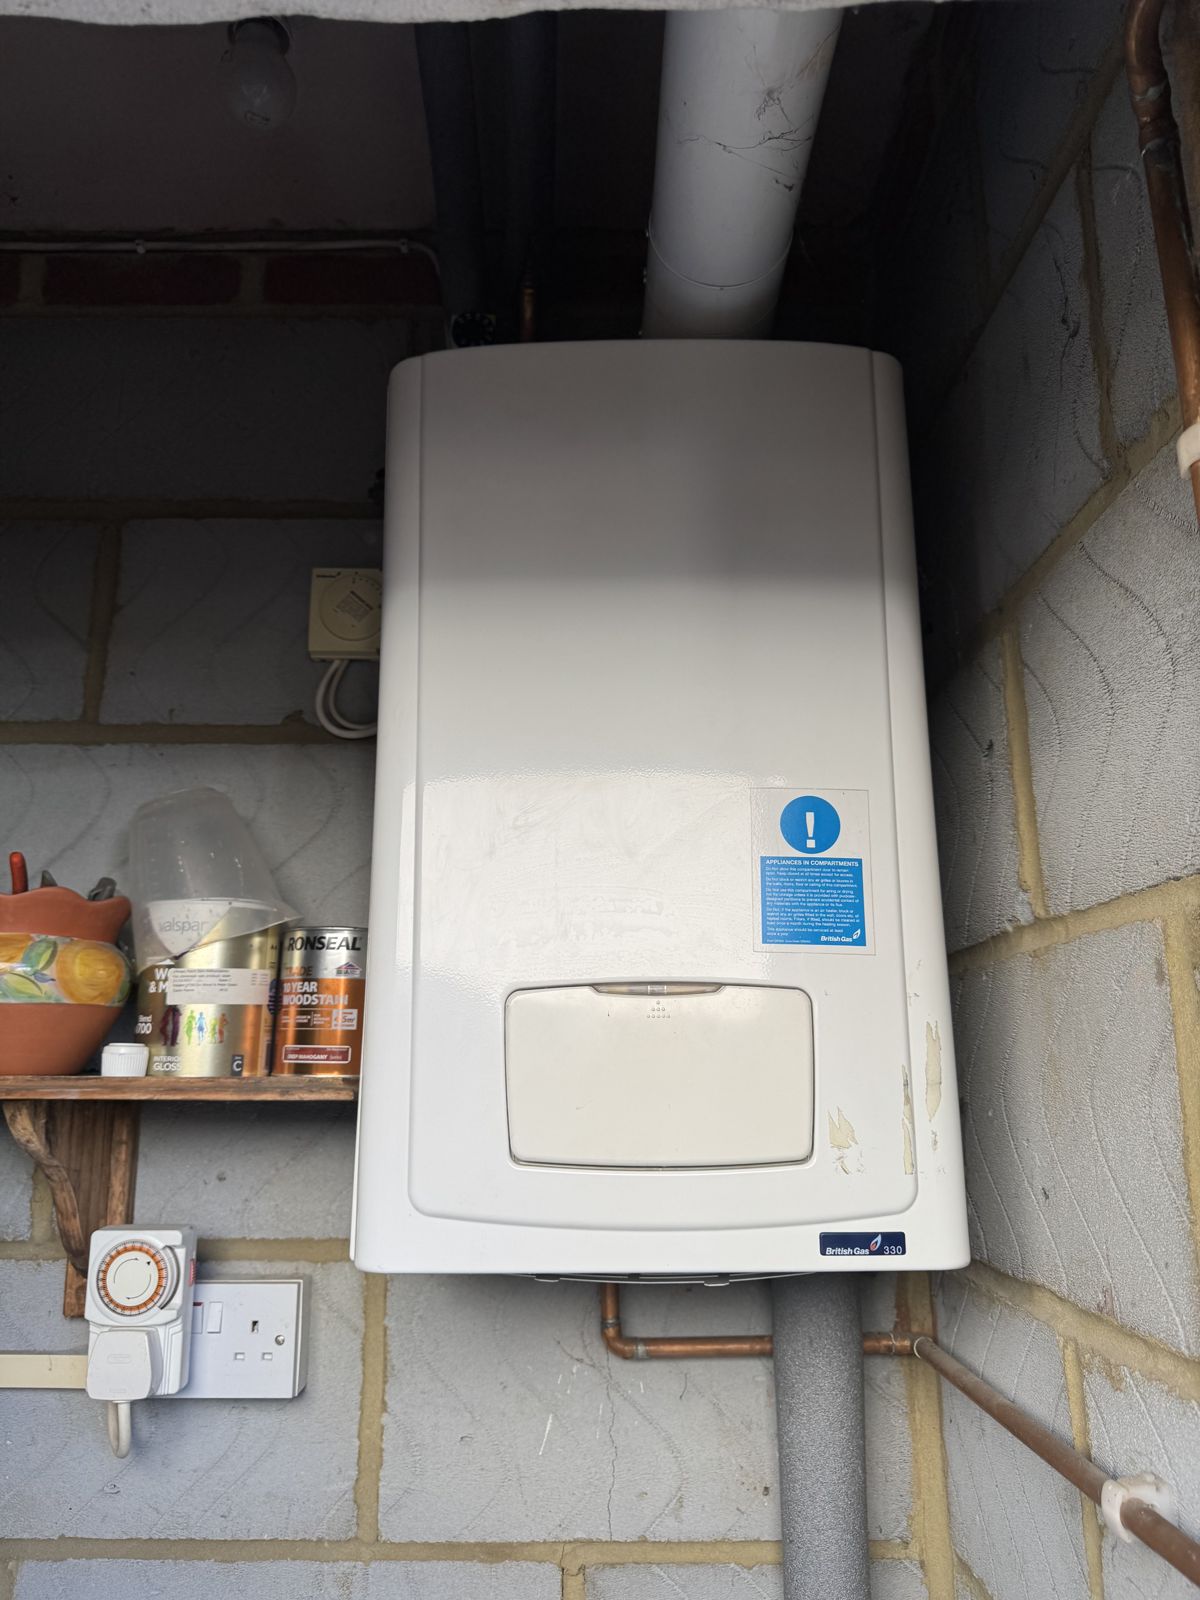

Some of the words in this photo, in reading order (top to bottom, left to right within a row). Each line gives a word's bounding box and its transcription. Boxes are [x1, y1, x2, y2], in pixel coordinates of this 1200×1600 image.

[288, 935, 362, 951] RONSEAL
[148, 980, 158, 993] &
[291, 981, 318, 993] YEAR
[282, 993, 349, 1006] WOODSTAIN
[153, 1062, 183, 1072] GLOSS
[233, 1060, 243, 1072] C
[825, 1247, 853, 1255] British
[853, 1247, 870, 1255] Gas
[883, 1245, 903, 1255] 330
